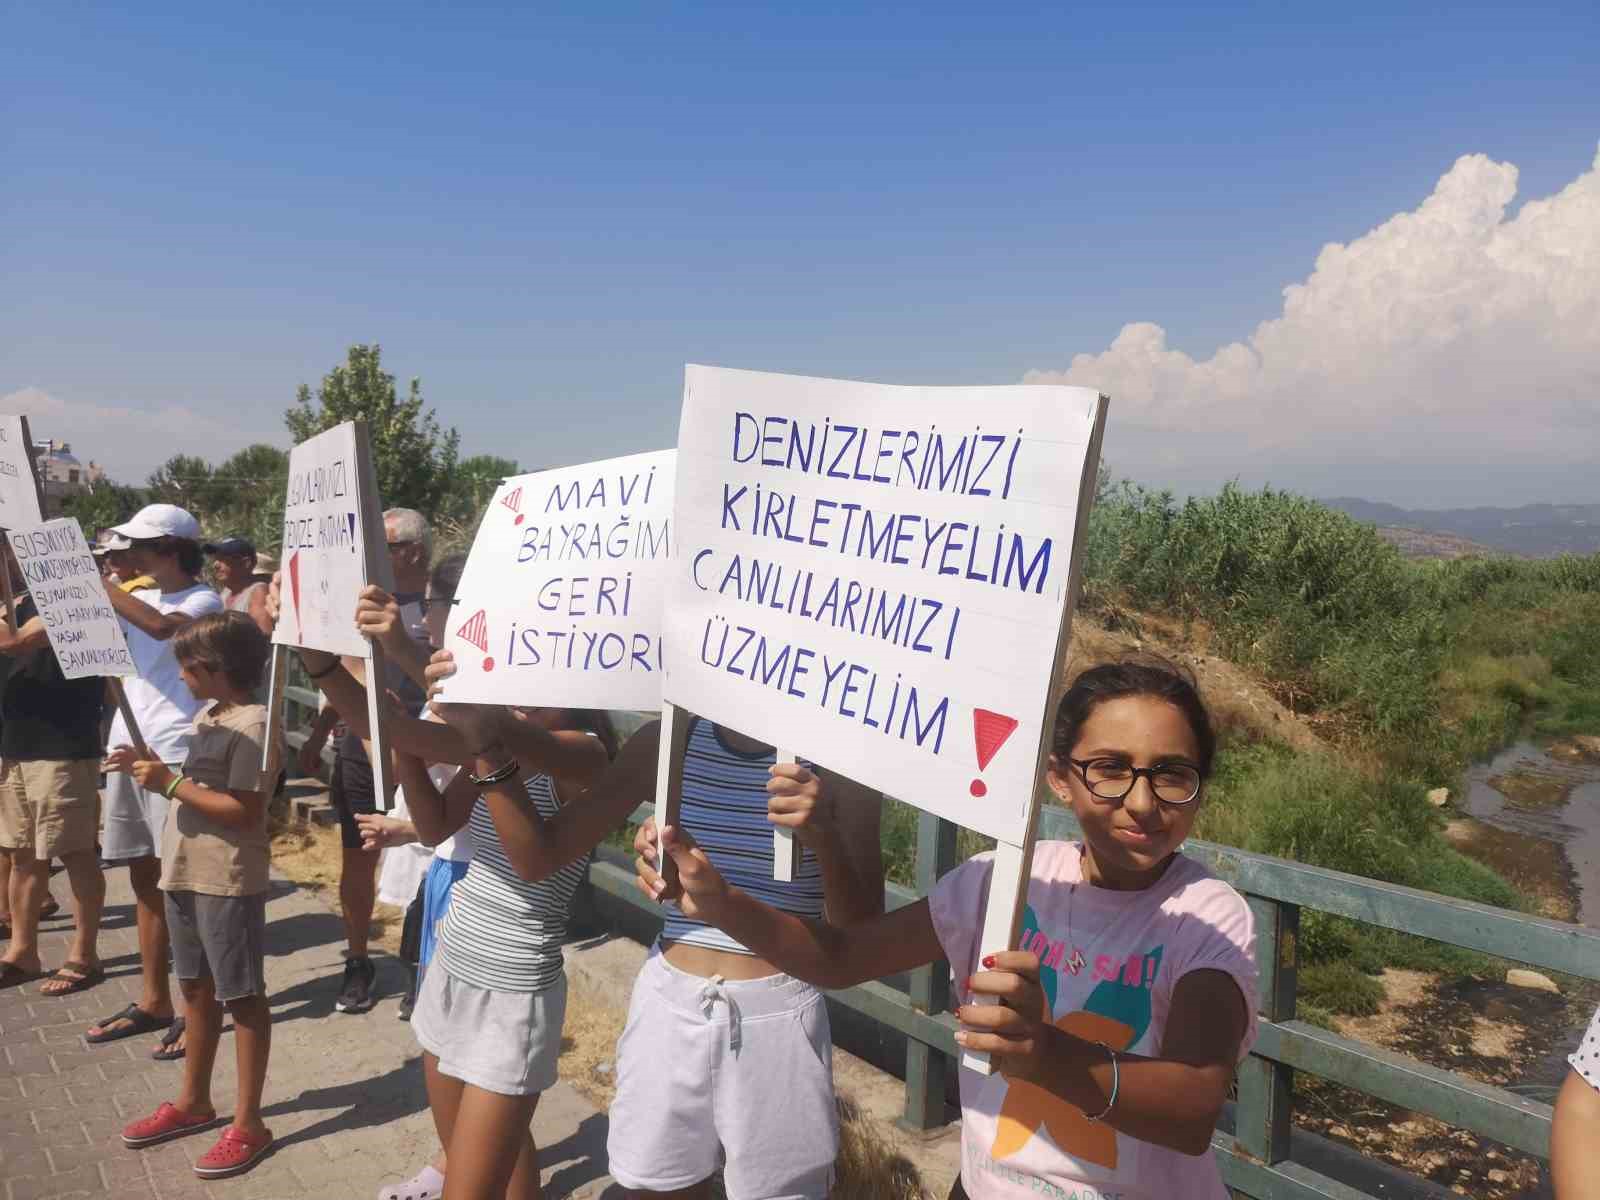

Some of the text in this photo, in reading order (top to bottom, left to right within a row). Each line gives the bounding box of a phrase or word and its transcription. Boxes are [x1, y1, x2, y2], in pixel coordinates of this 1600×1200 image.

[545, 466, 656, 512] MAVİ
[733, 411, 1023, 499] DENİZLERİMİZİ
[517, 515, 669, 562] BAYRAĞIM
[722, 483, 1052, 594] KİRLETMEYELİM
[537, 572, 632, 616] GERİ
[694, 549, 960, 659] CANLILARIMIZI
[508, 623, 662, 671] İSTİYOR
[701, 615, 949, 754] ÜZMEYELİM
